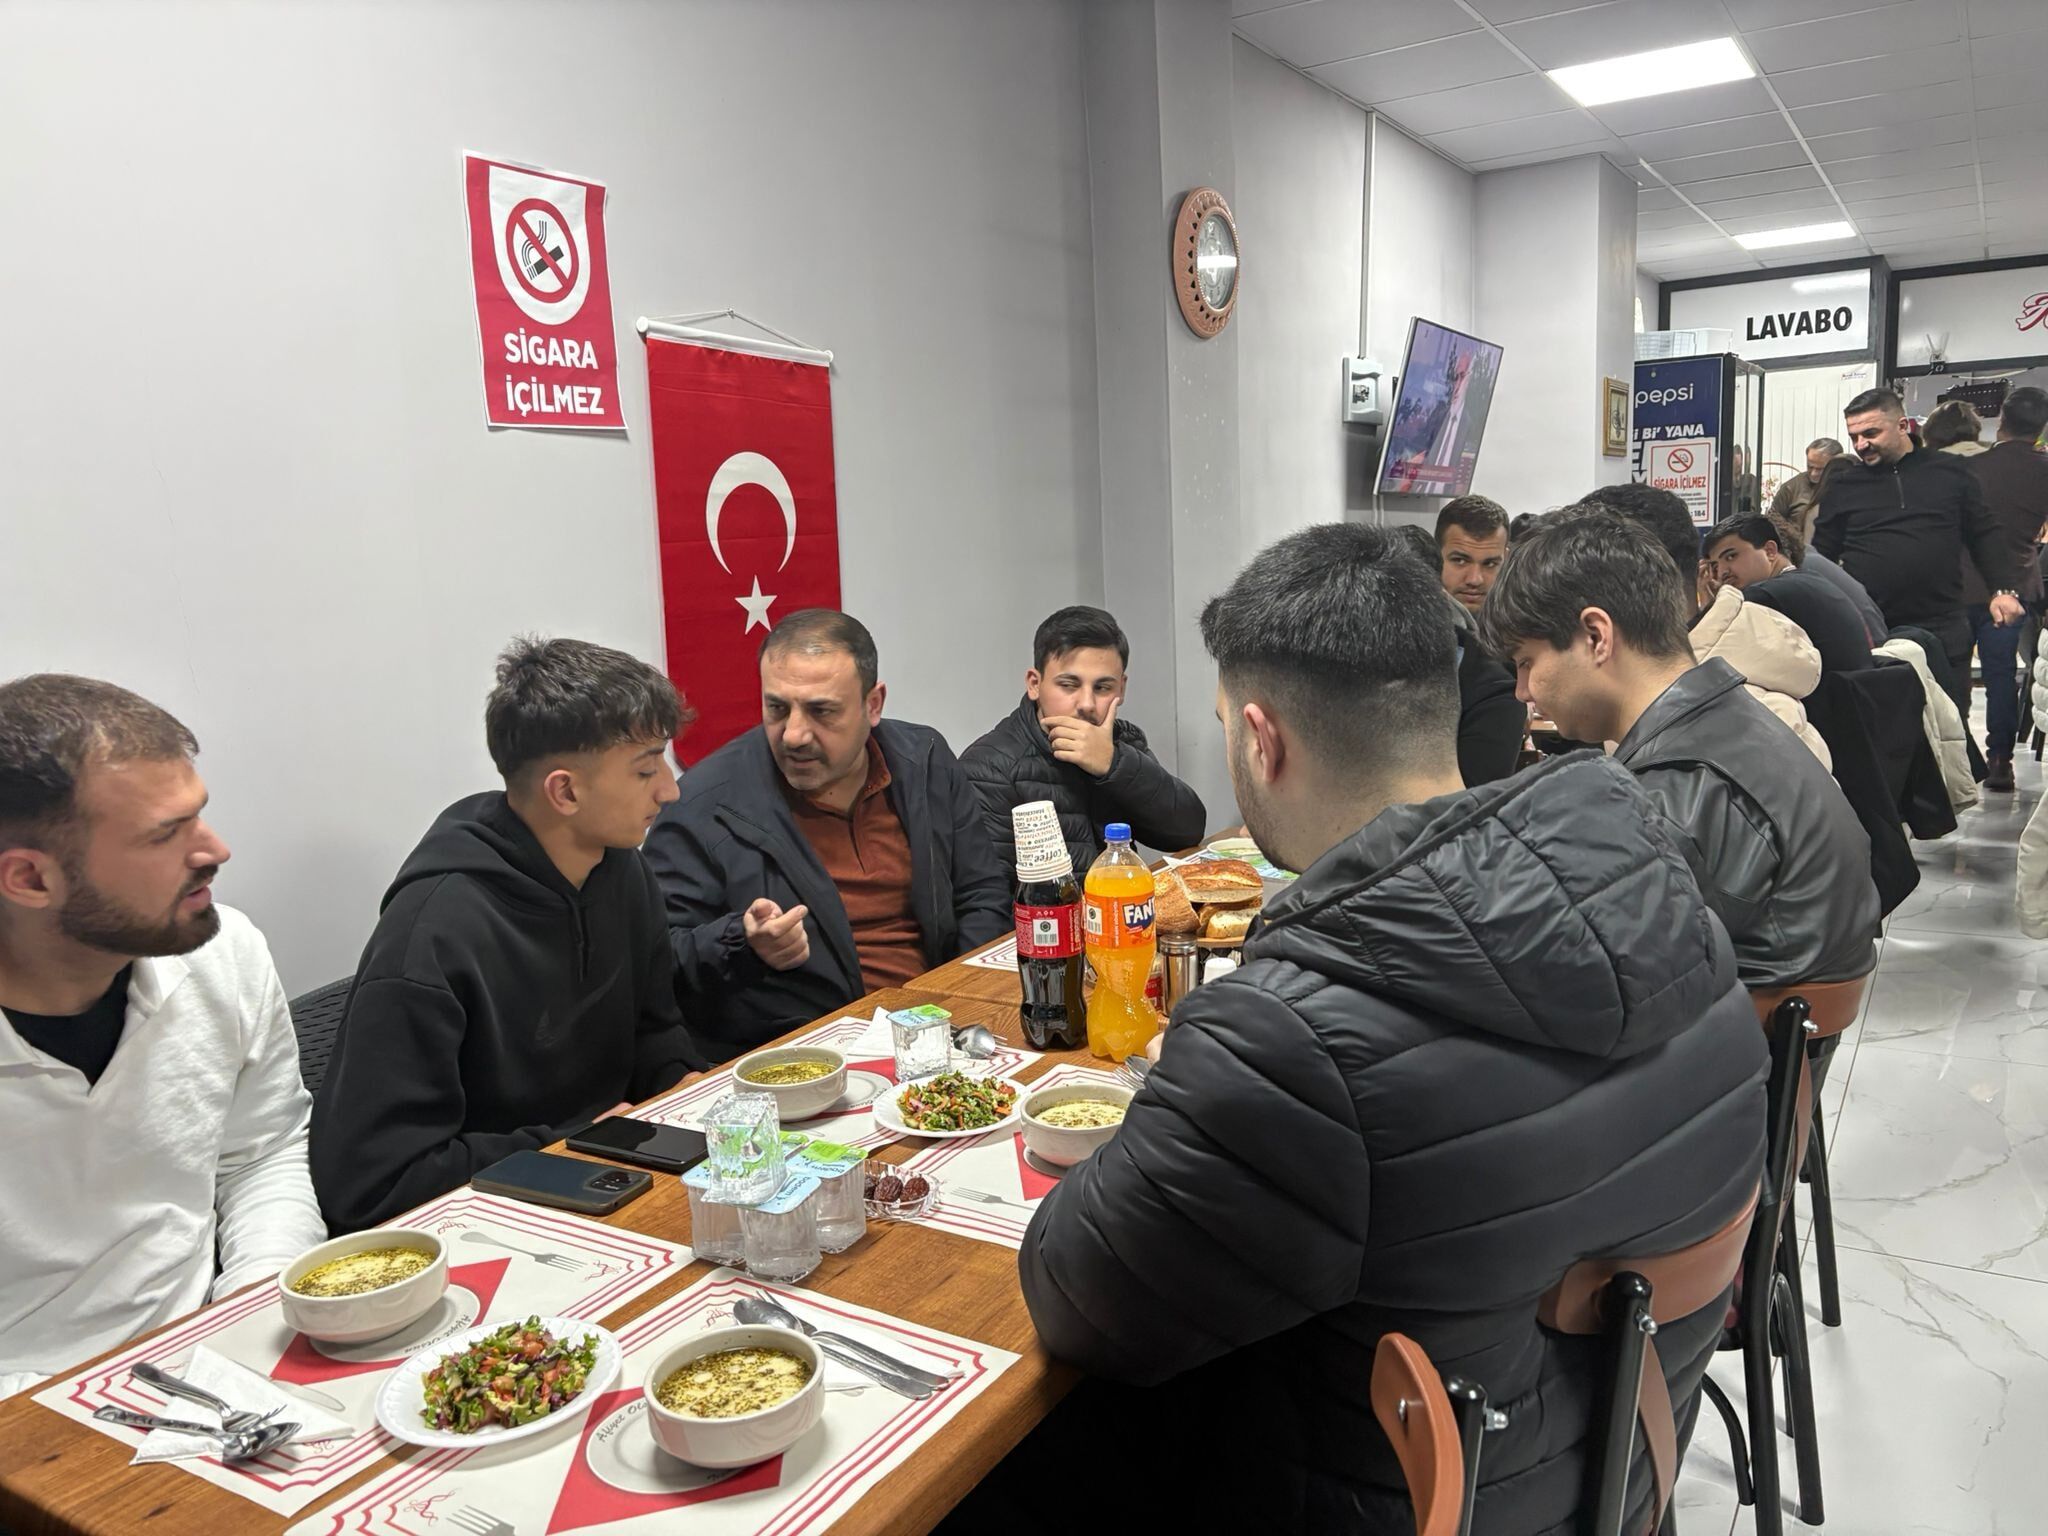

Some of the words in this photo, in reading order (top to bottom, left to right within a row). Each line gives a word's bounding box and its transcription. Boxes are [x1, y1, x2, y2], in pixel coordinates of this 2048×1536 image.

[1746, 306, 1853, 341] LAVABO
[503, 327, 599, 370] SİGARA
[505, 374, 605, 418] İÇİLMEZ
[1635, 383, 1694, 409] pepsi
[1664, 423, 1705, 438] YANA
[1654, 476, 1679, 489] SİGARA
[1679, 475, 1706, 490] İÇİLMEZ
[1034, 849, 1062, 862] Coffee
